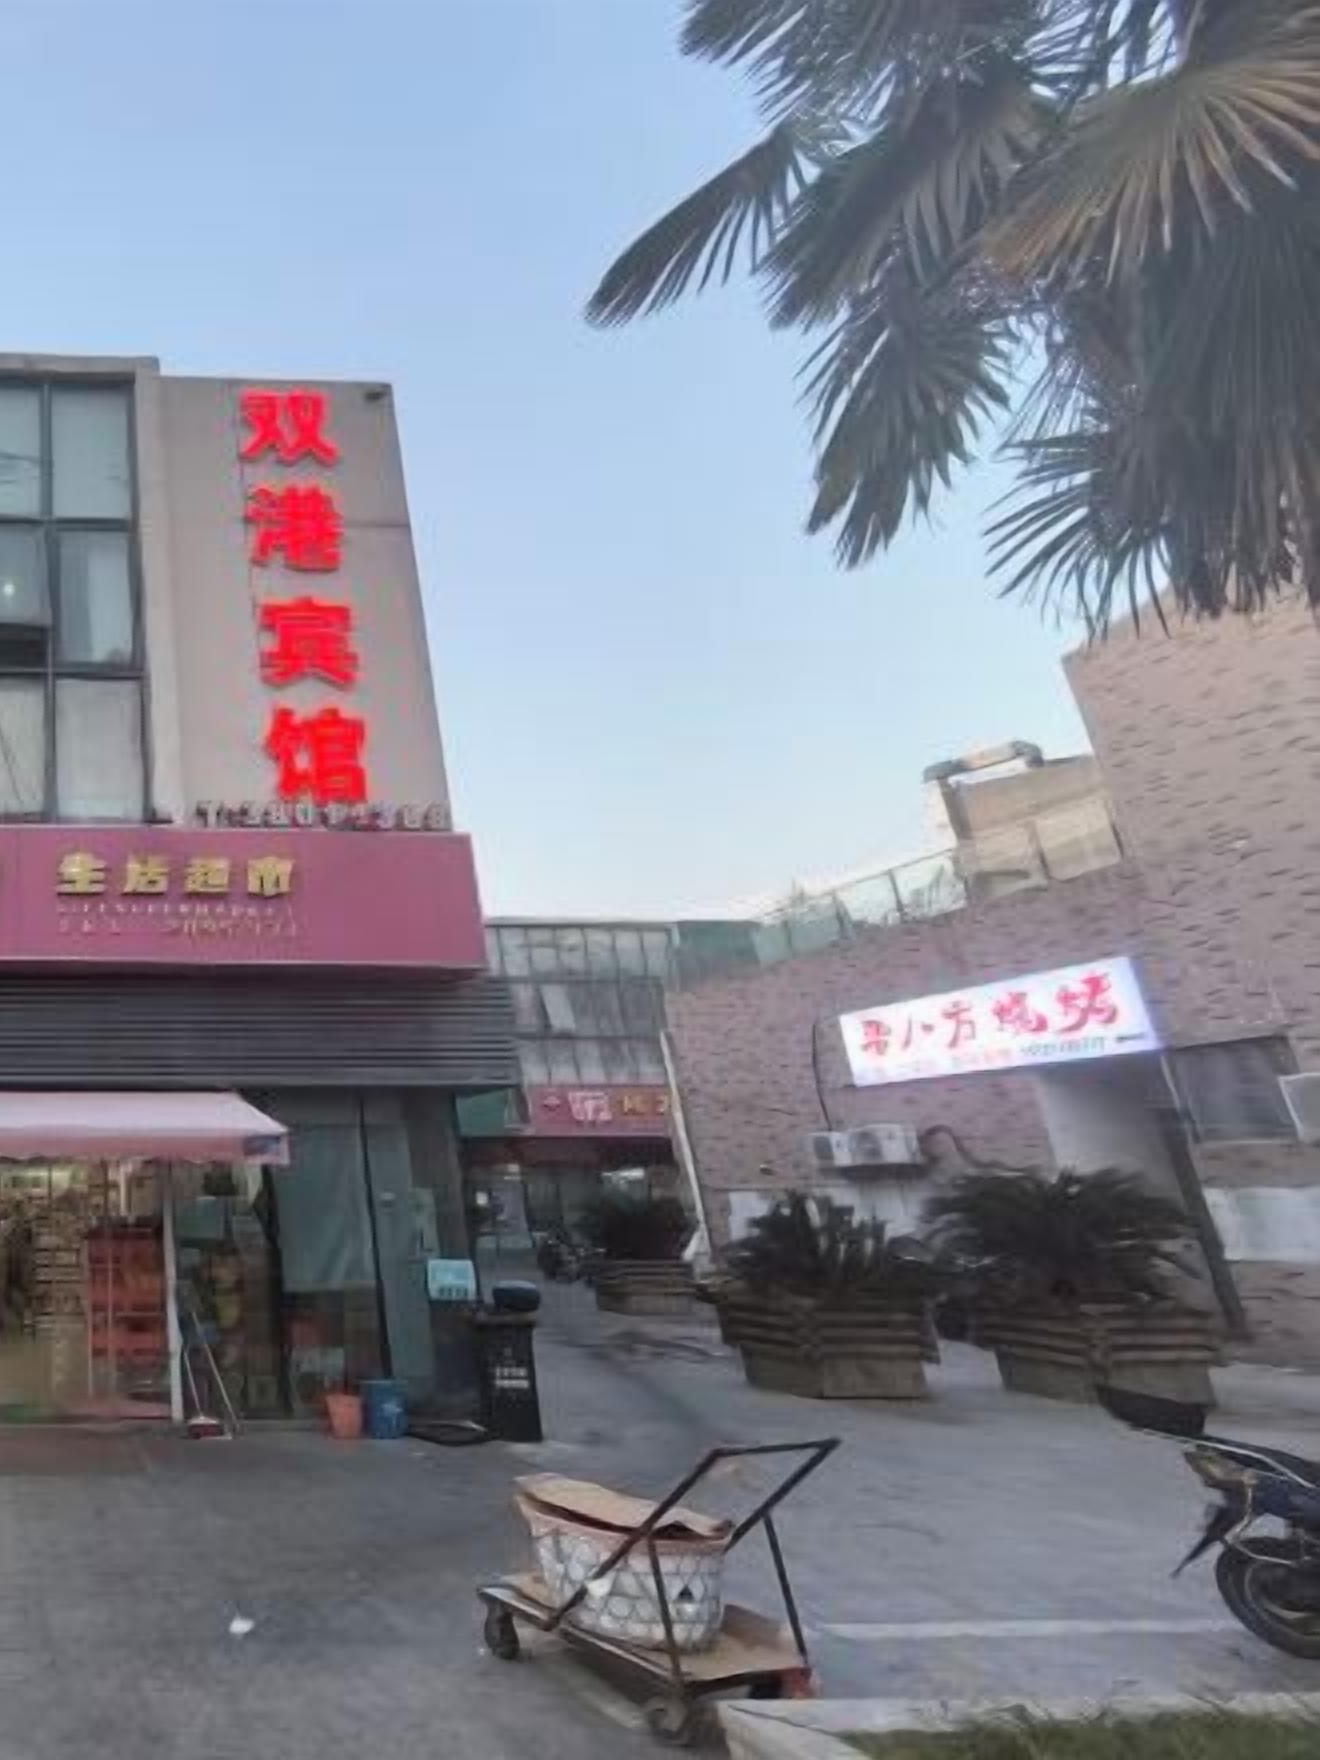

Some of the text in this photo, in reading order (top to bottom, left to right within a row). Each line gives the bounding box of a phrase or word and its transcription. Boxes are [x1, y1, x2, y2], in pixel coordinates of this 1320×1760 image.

[237, 388, 369, 806] 双港宾馆
[56, 851, 295, 898] 生活超市
